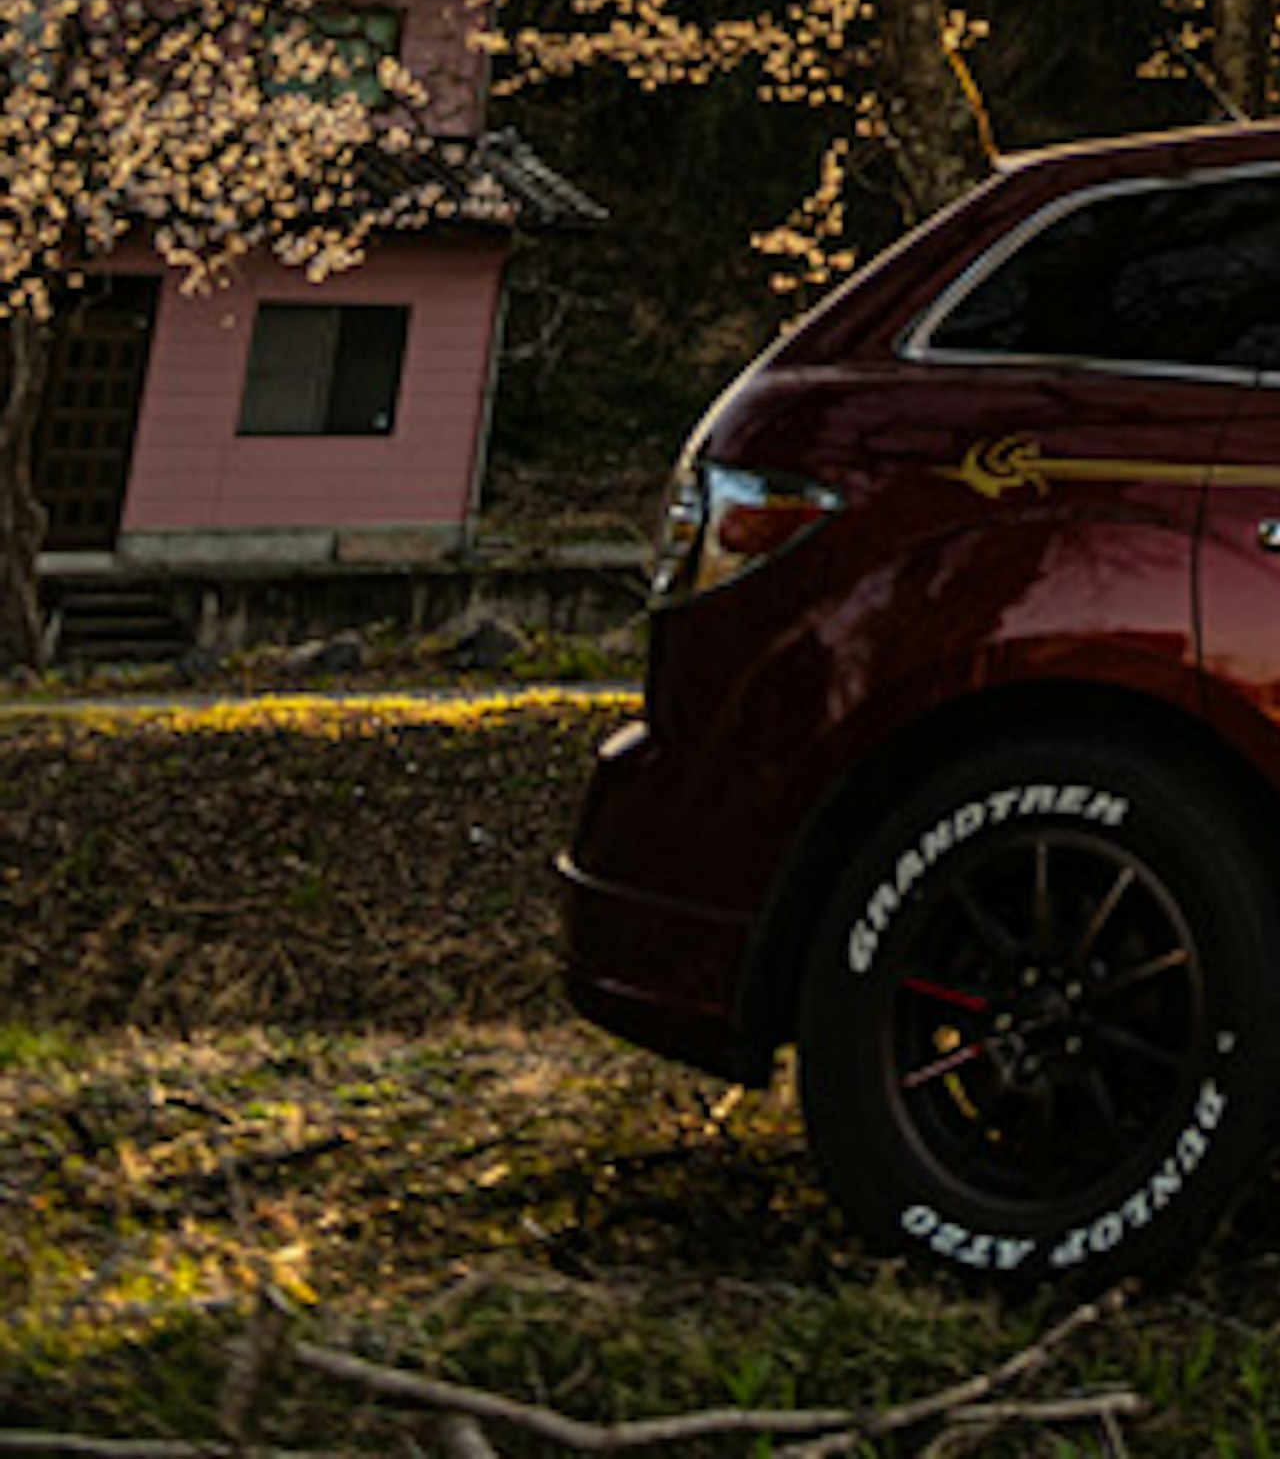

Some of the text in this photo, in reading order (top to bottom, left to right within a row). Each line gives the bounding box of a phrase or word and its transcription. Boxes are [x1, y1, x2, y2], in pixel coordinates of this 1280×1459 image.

[848, 784, 1129, 975] GRANDTREK
[899, 1077, 1228, 1273] DUNLOP AT20
